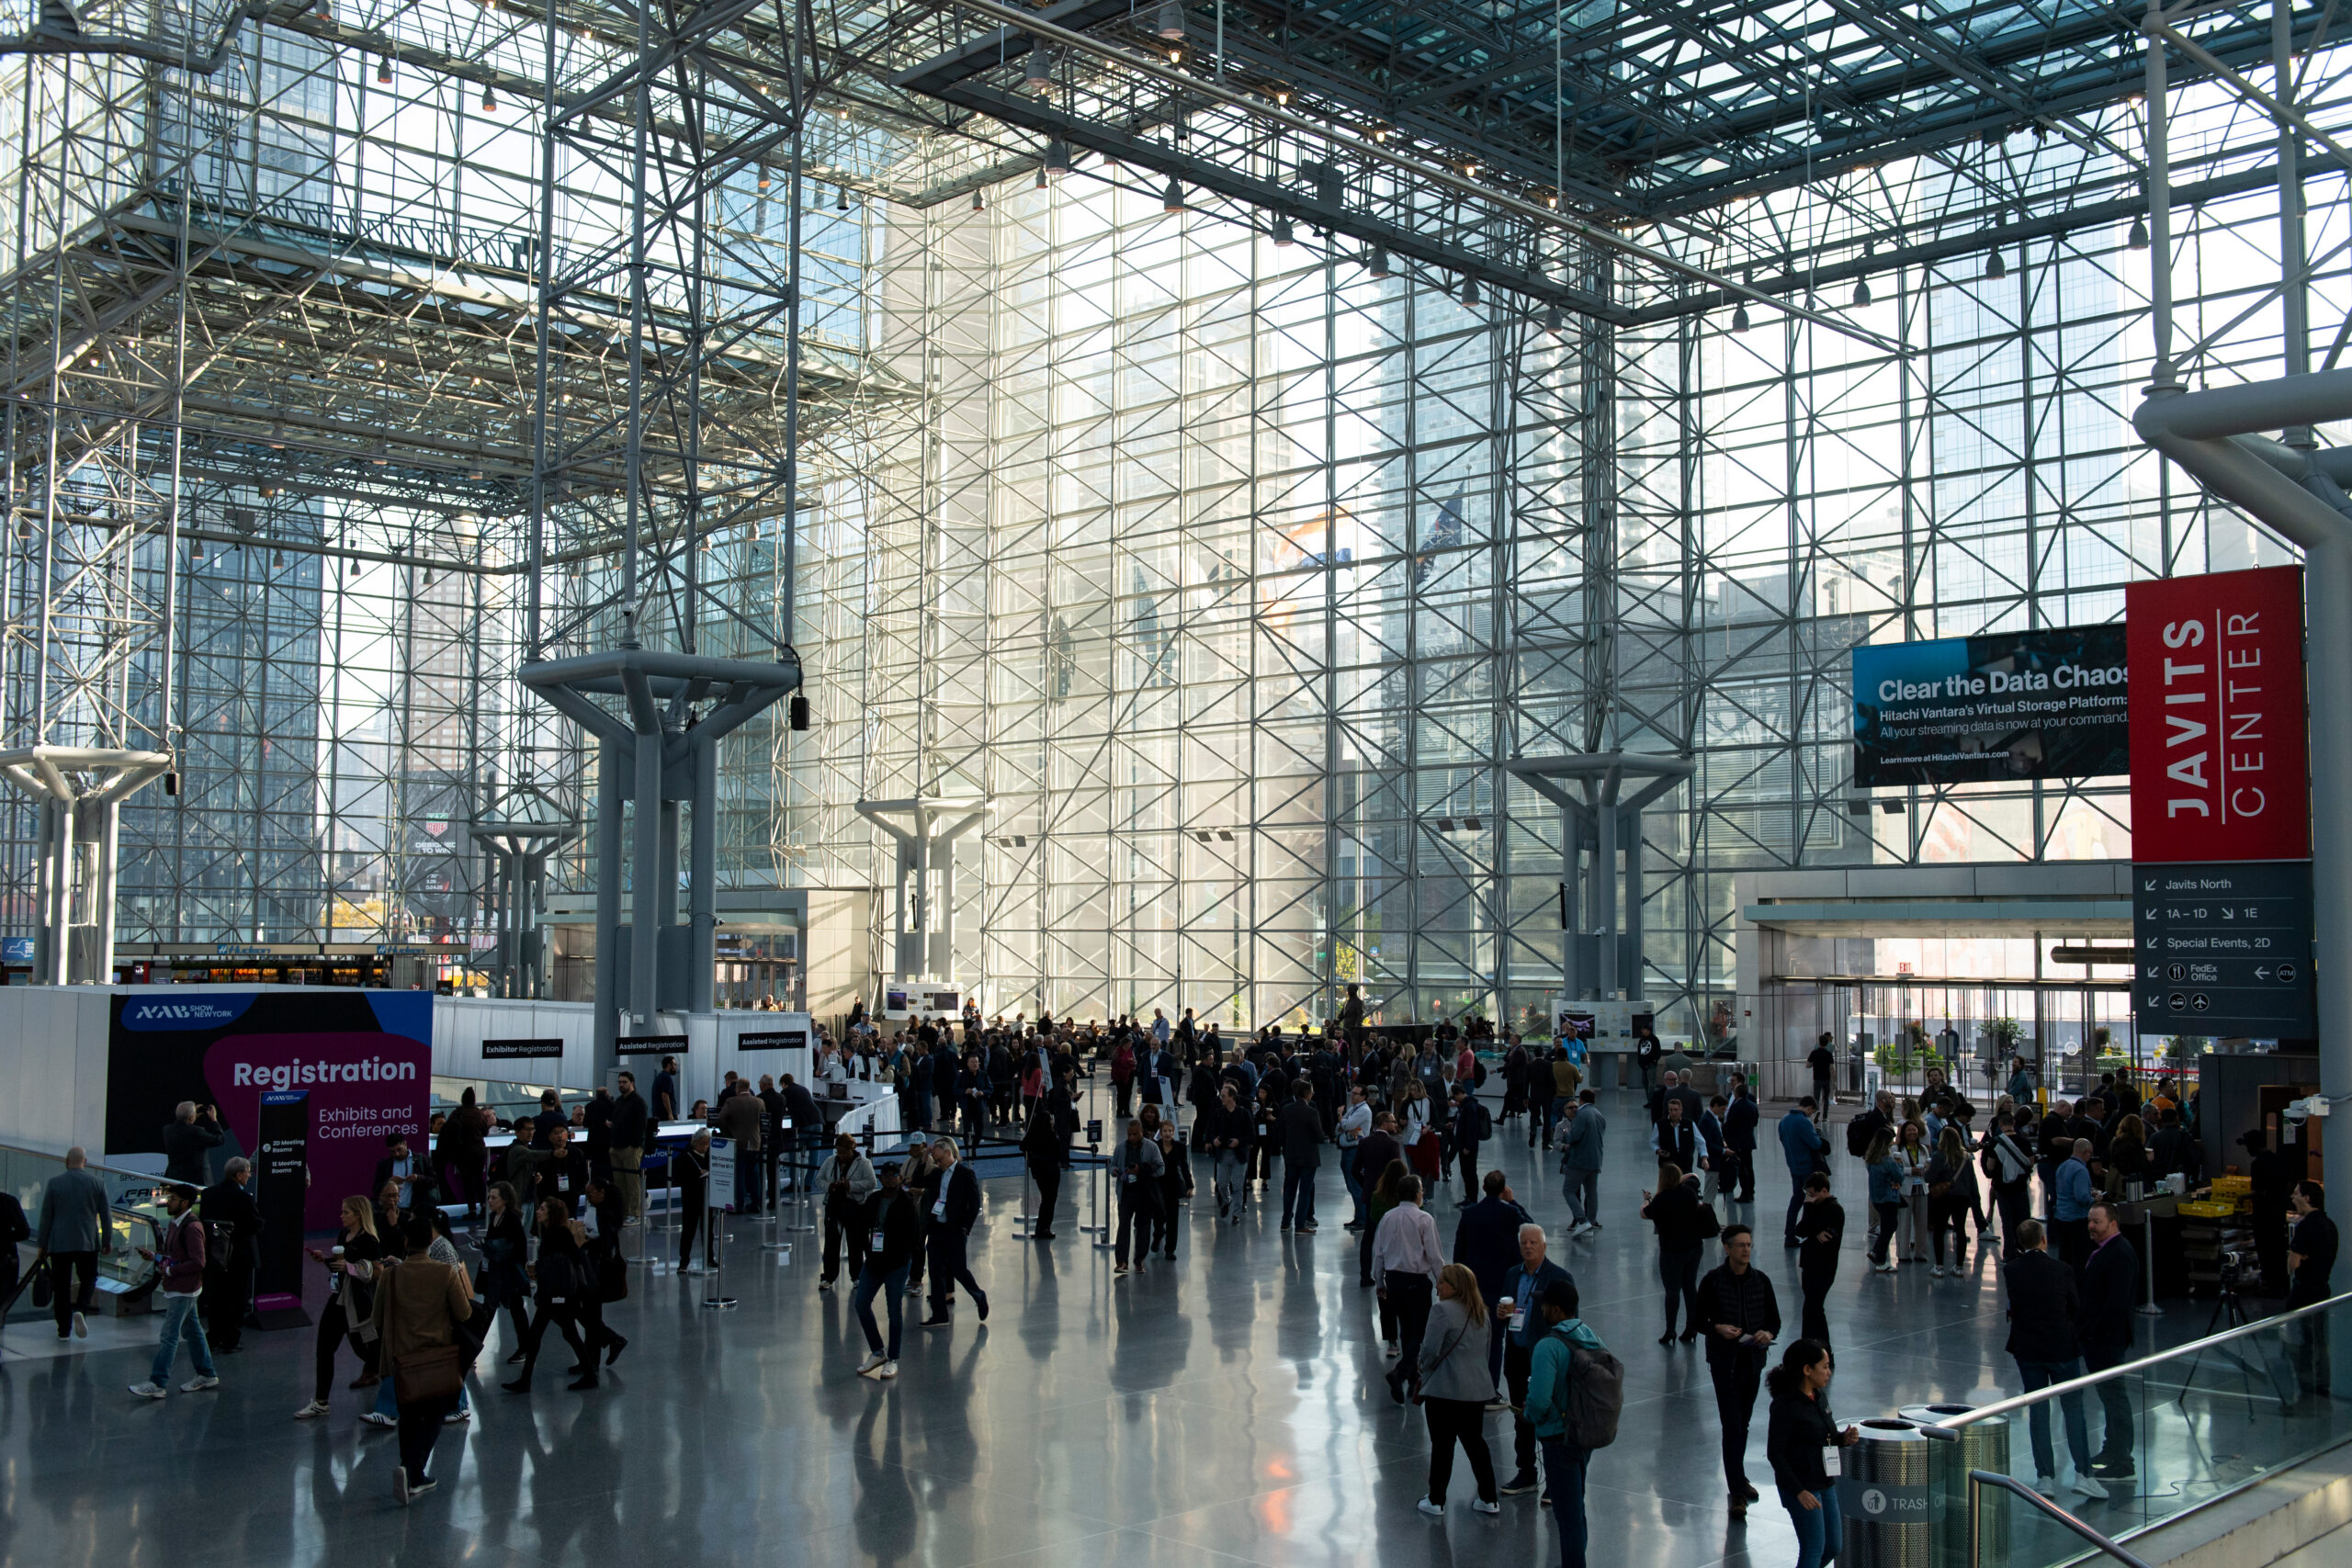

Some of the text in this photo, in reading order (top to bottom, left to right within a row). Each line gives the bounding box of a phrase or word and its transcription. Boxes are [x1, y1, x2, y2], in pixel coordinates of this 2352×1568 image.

[1879, 679, 1942, 702] Clear
[1945, 674, 1985, 697] the
[1990, 670, 2049, 694] Data
[1880, 708, 1919, 722] Hitachi
[1976, 702, 2015, 716] Virtual
[2018, 700, 2067, 715] Storage
[2069, 694, 2128, 709] Platform:
[2163, 619, 2210, 818] JAVITS
[2227, 612, 2266, 818] CENTER
[1881, 711, 2129, 739] All your streaming data is now at your command.
[1880, 750, 2009, 764] Learn more at HitachiVantara.com
[2165, 879, 2232, 890] Javits North
[2166, 908, 2181, 919] 1A
[2192, 908, 2208, 919] 1D
[2244, 908, 2258, 918] 1E
[2167, 937, 2271, 950] Special Events, 2D
[1899, 962, 1911, 973] EXIT
[2190, 964, 2218, 973] FedEx
[2190, 973, 2218, 981] Office
[648, 1041, 685, 1051] Registration
[768, 1036, 803, 1046] Registration
[486, 1044, 560, 1055] Exhibitor Registration
[233, 1055, 416, 1091] Registration
[319, 1104, 413, 1122] Exhibits and
[318, 1122, 419, 1139] Conferences
